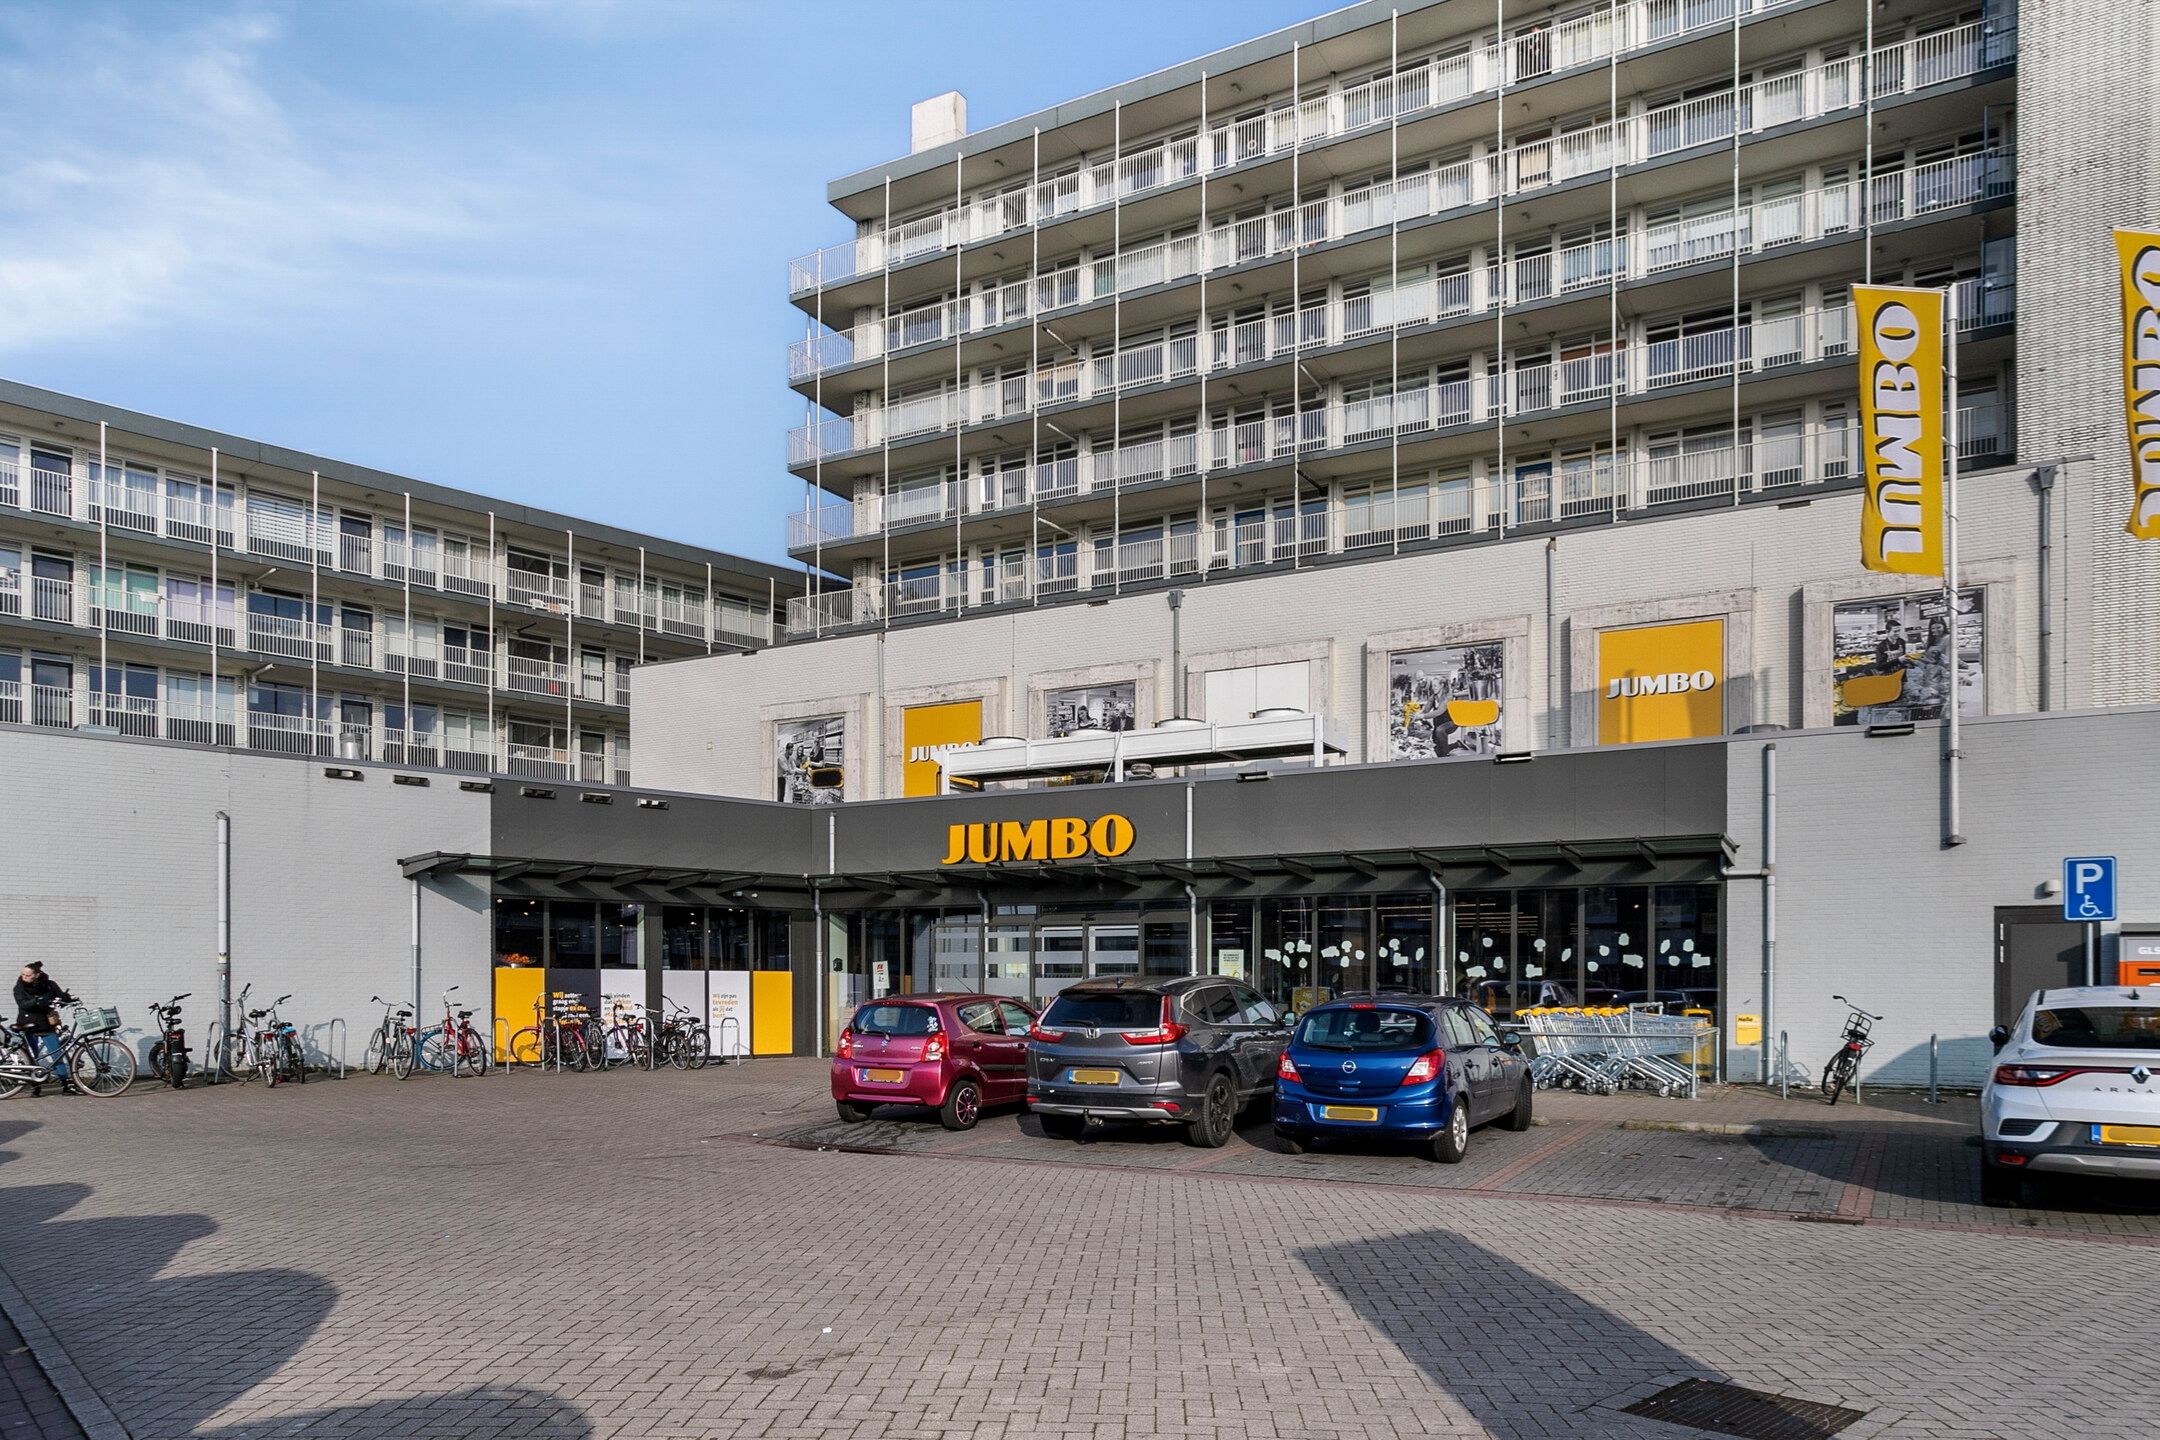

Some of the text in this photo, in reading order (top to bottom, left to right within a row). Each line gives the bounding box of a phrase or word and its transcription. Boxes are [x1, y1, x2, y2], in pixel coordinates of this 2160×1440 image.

[1606, 670, 1716, 699] JUMBO
[941, 814, 1137, 866] JUMBO
[2075, 863, 2103, 894] P
